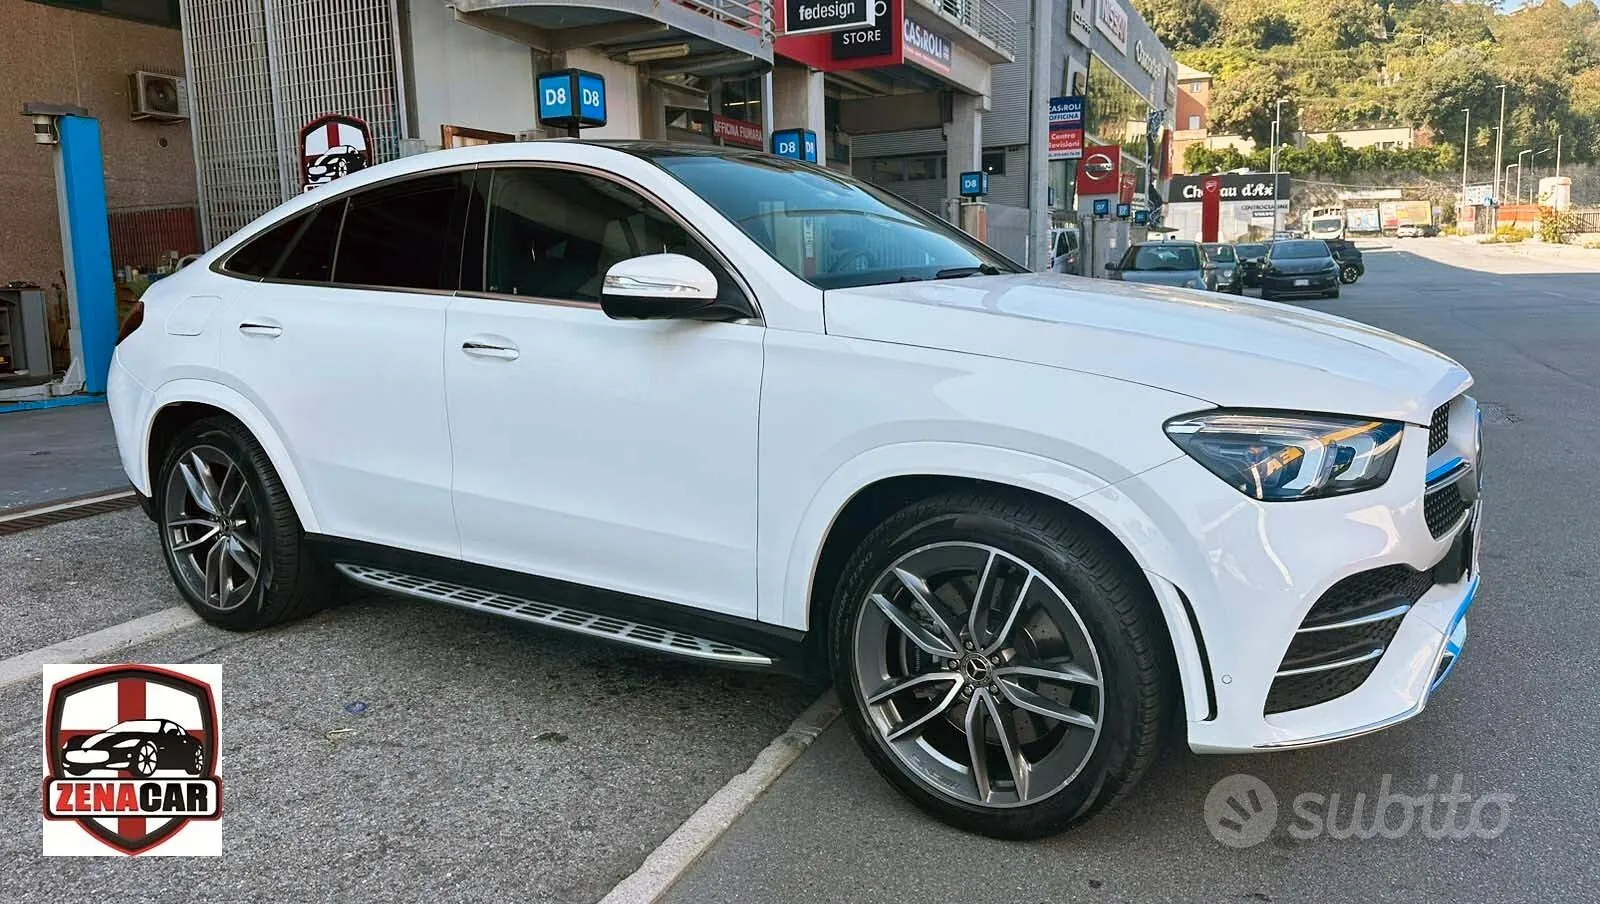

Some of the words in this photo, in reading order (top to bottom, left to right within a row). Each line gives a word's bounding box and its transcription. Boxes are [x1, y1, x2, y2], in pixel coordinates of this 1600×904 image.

[799, 1, 856, 20] fedesign
[843, 29, 881, 45] STORE
[545, 87, 567, 106] D8
[582, 87, 600, 107] D8
[1048, 112, 1079, 120] OFFICINA
[779, 142, 796, 154] D8
[964, 179, 977, 189] D8
[1182, 184, 1238, 199] Chau
